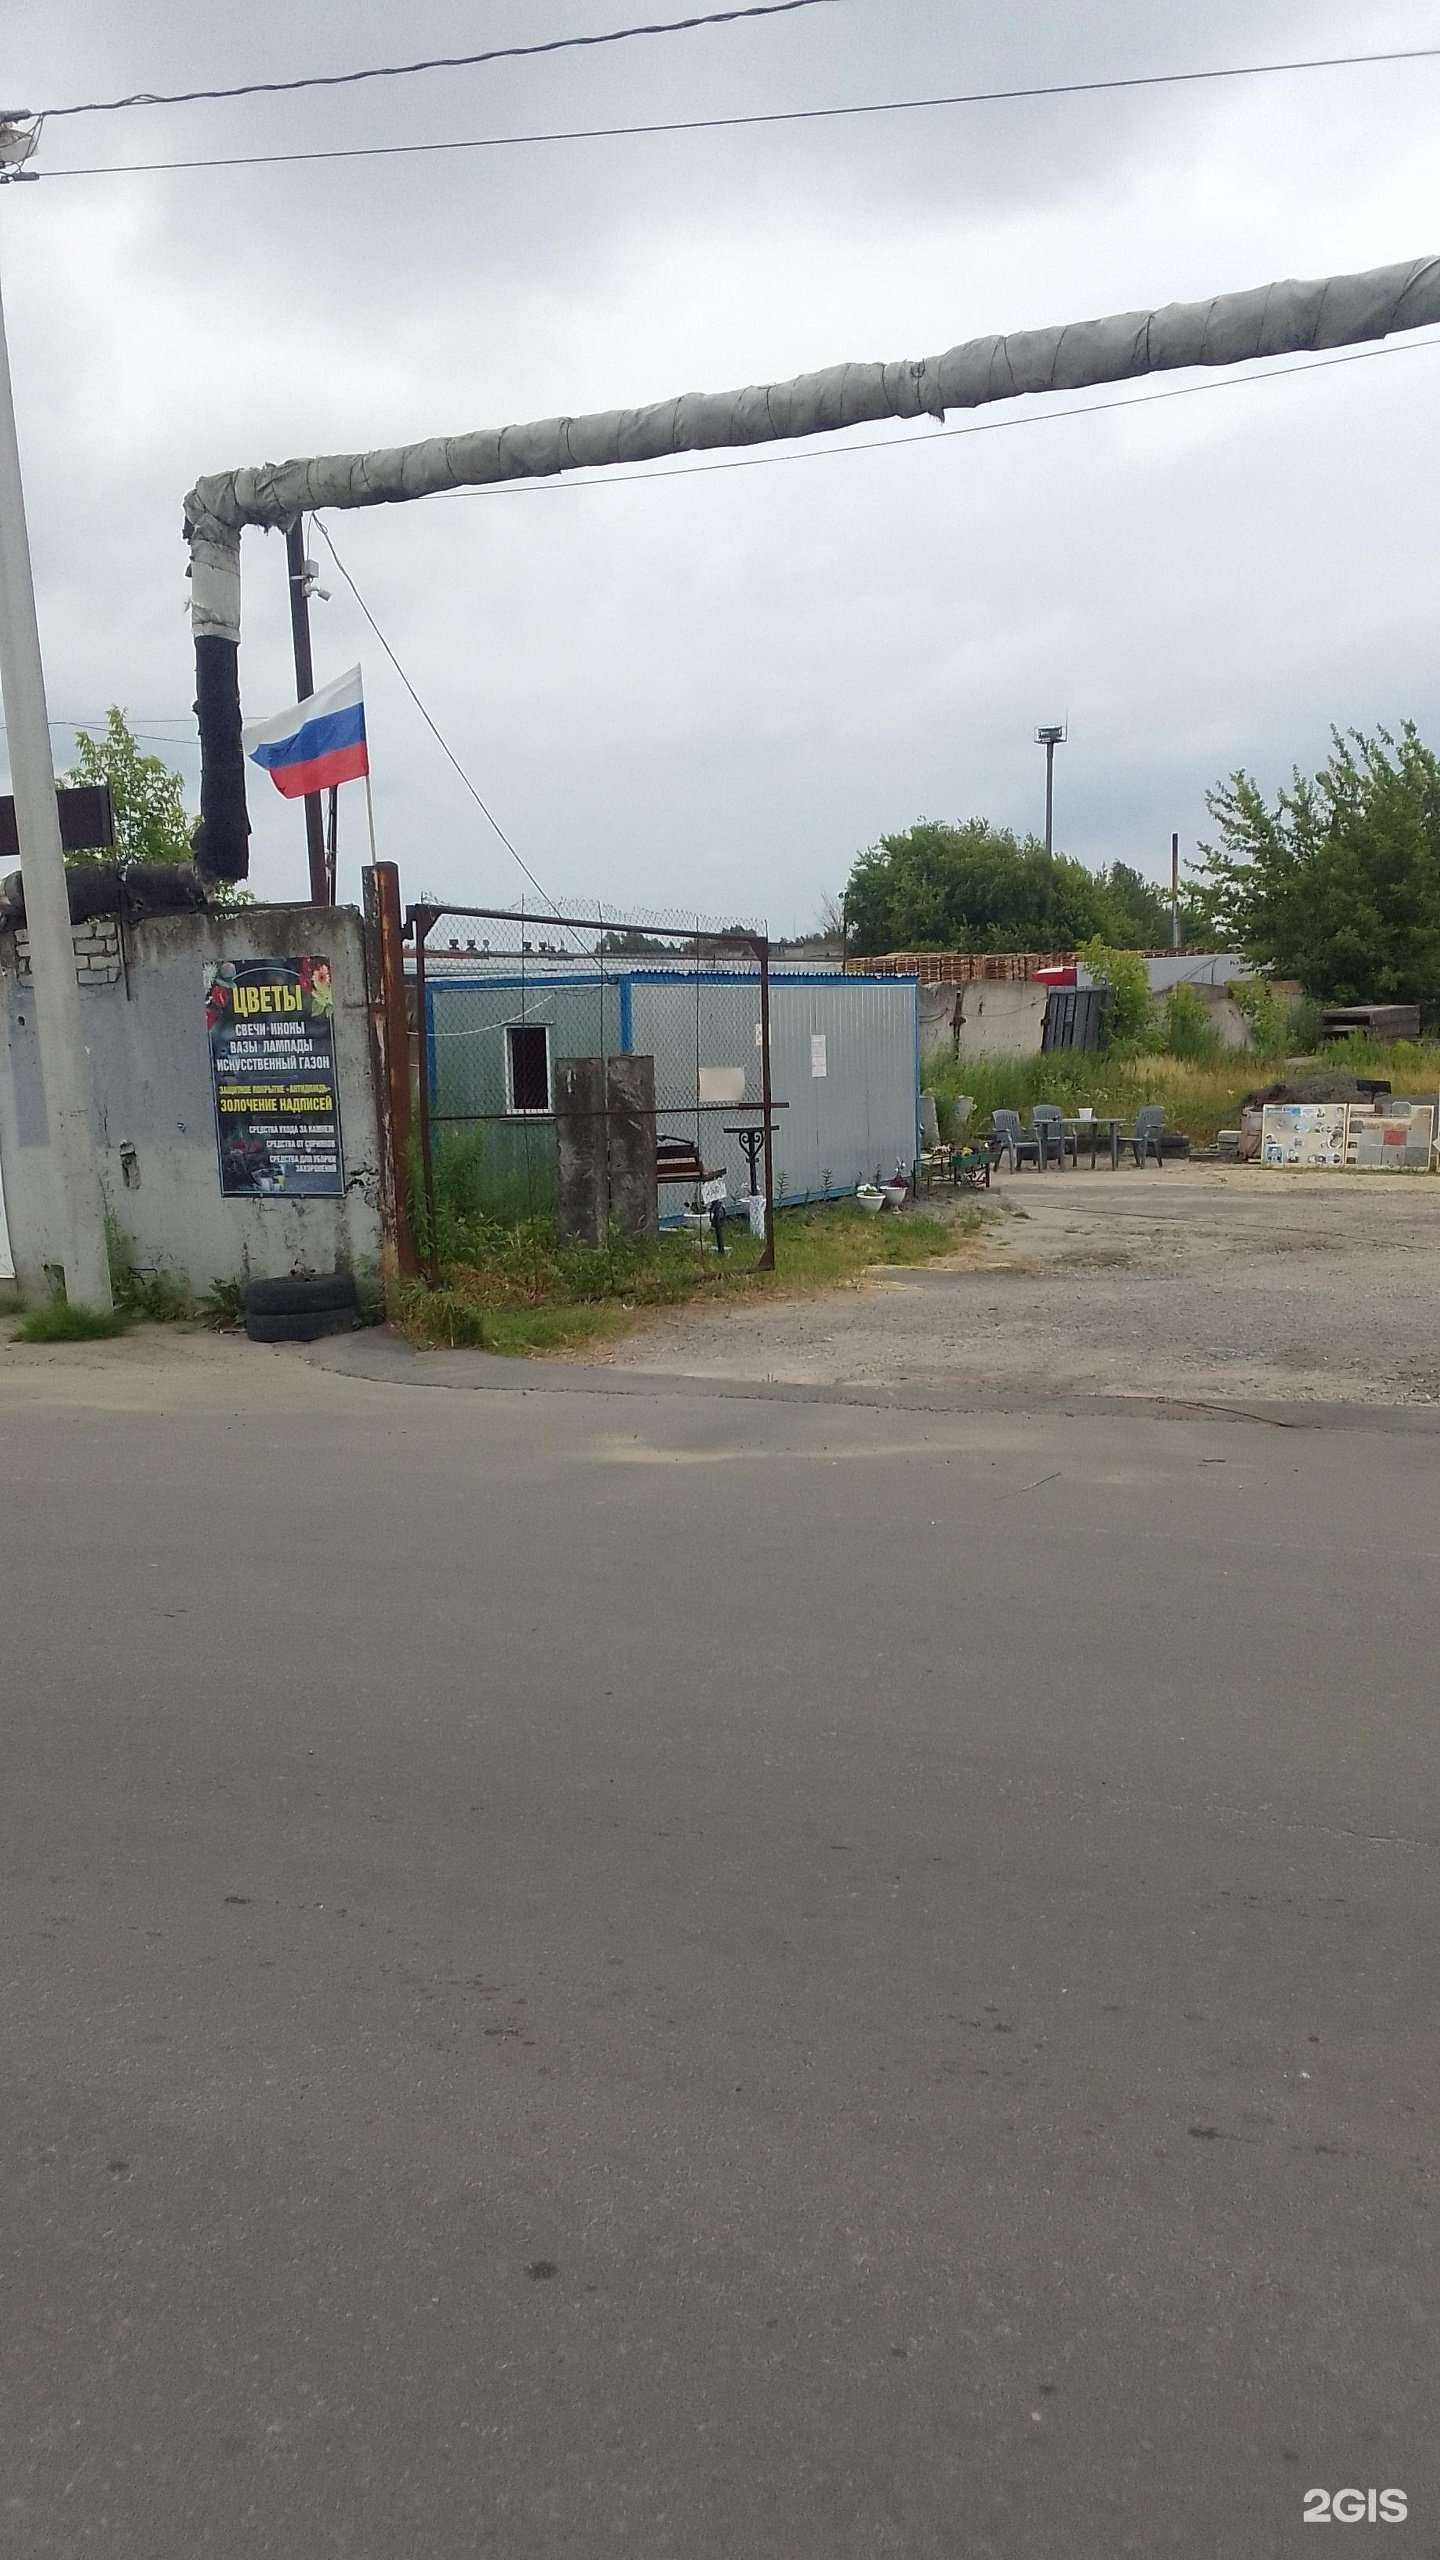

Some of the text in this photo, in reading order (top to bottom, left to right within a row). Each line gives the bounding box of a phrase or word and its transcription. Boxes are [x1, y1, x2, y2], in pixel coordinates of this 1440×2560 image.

[232, 985, 303, 1017] ЦВЕТЫ
[235, 1022, 305, 1036] СВЕЧИ ИКОНЫ
[230, 1039, 313, 1053] ВАЗЫ ЛАМПАДЫ
[216, 1055, 330, 1071] ИСКУССТВЕННЫЙ ГАЗОН
[220, 1095, 333, 1113] ЗОЛОЧЕНИЕ НАДПИСЕЙ
